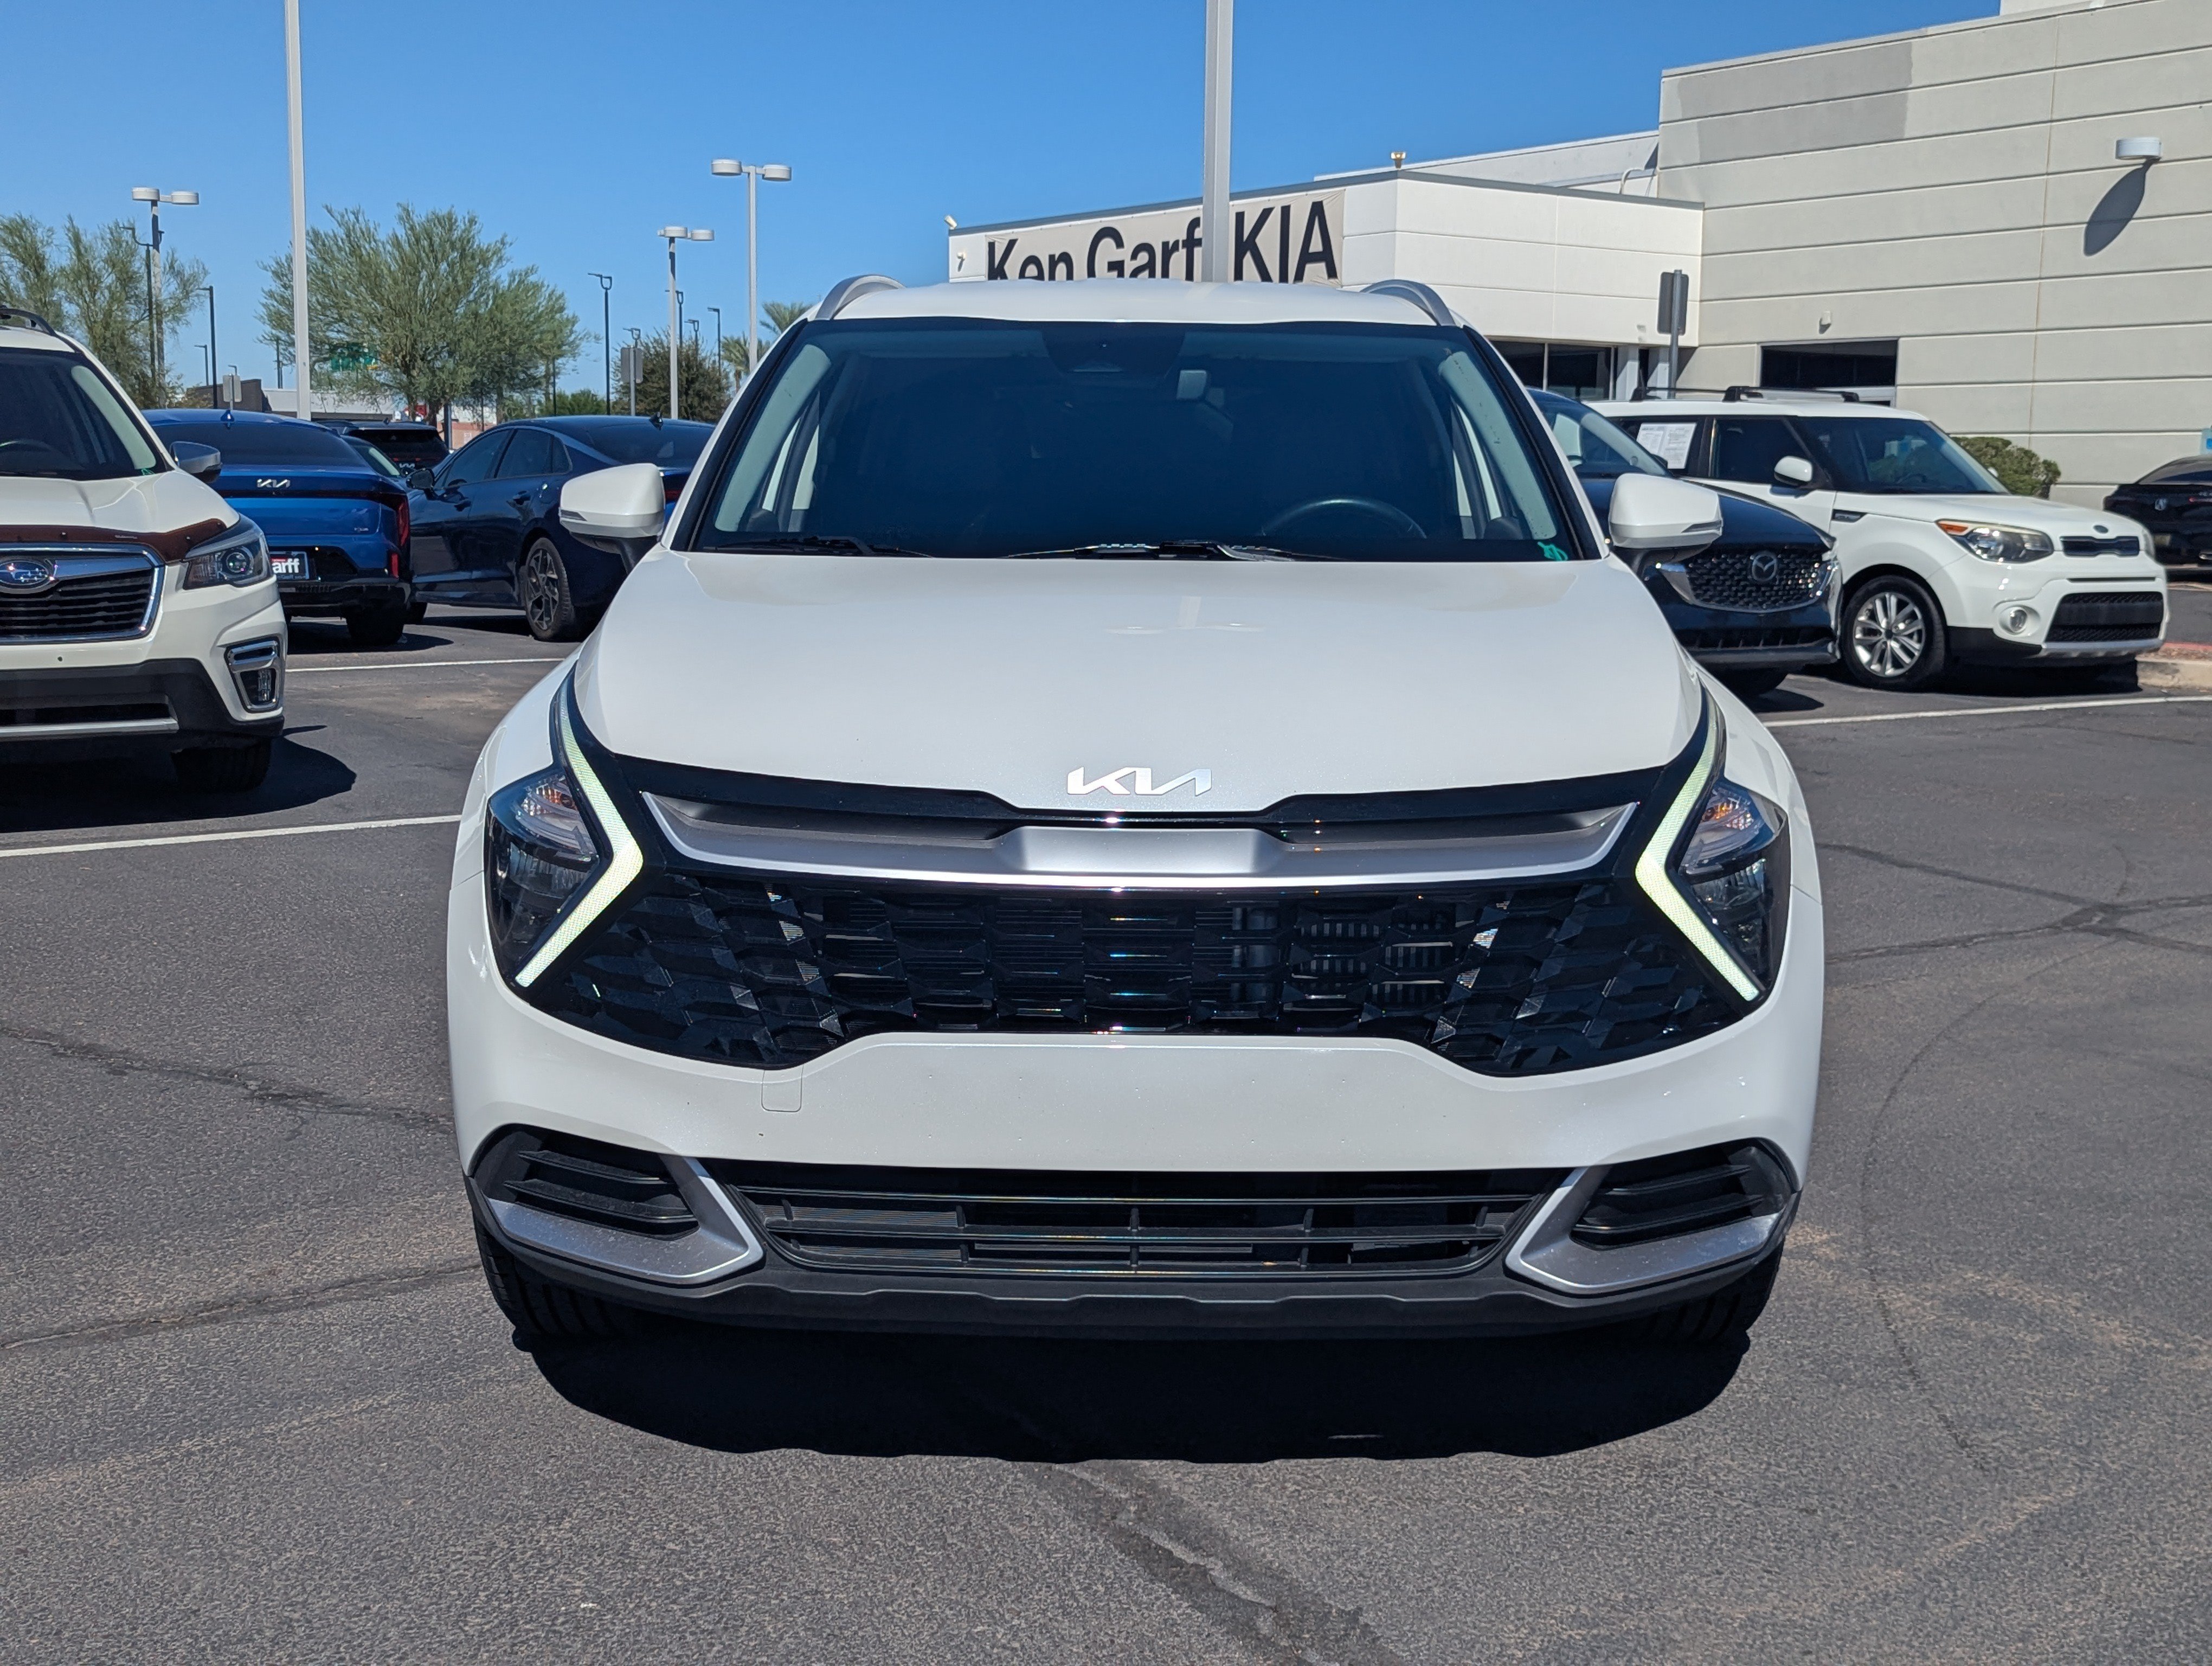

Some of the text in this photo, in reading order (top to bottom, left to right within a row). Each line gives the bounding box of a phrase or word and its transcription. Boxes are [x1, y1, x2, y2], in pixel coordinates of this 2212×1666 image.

[988, 200, 1338, 284] Ken Garf KIA
[257, 479, 291, 488] KIA
[272, 558, 299, 573] arff
[1067, 767, 1212, 797] KIA
